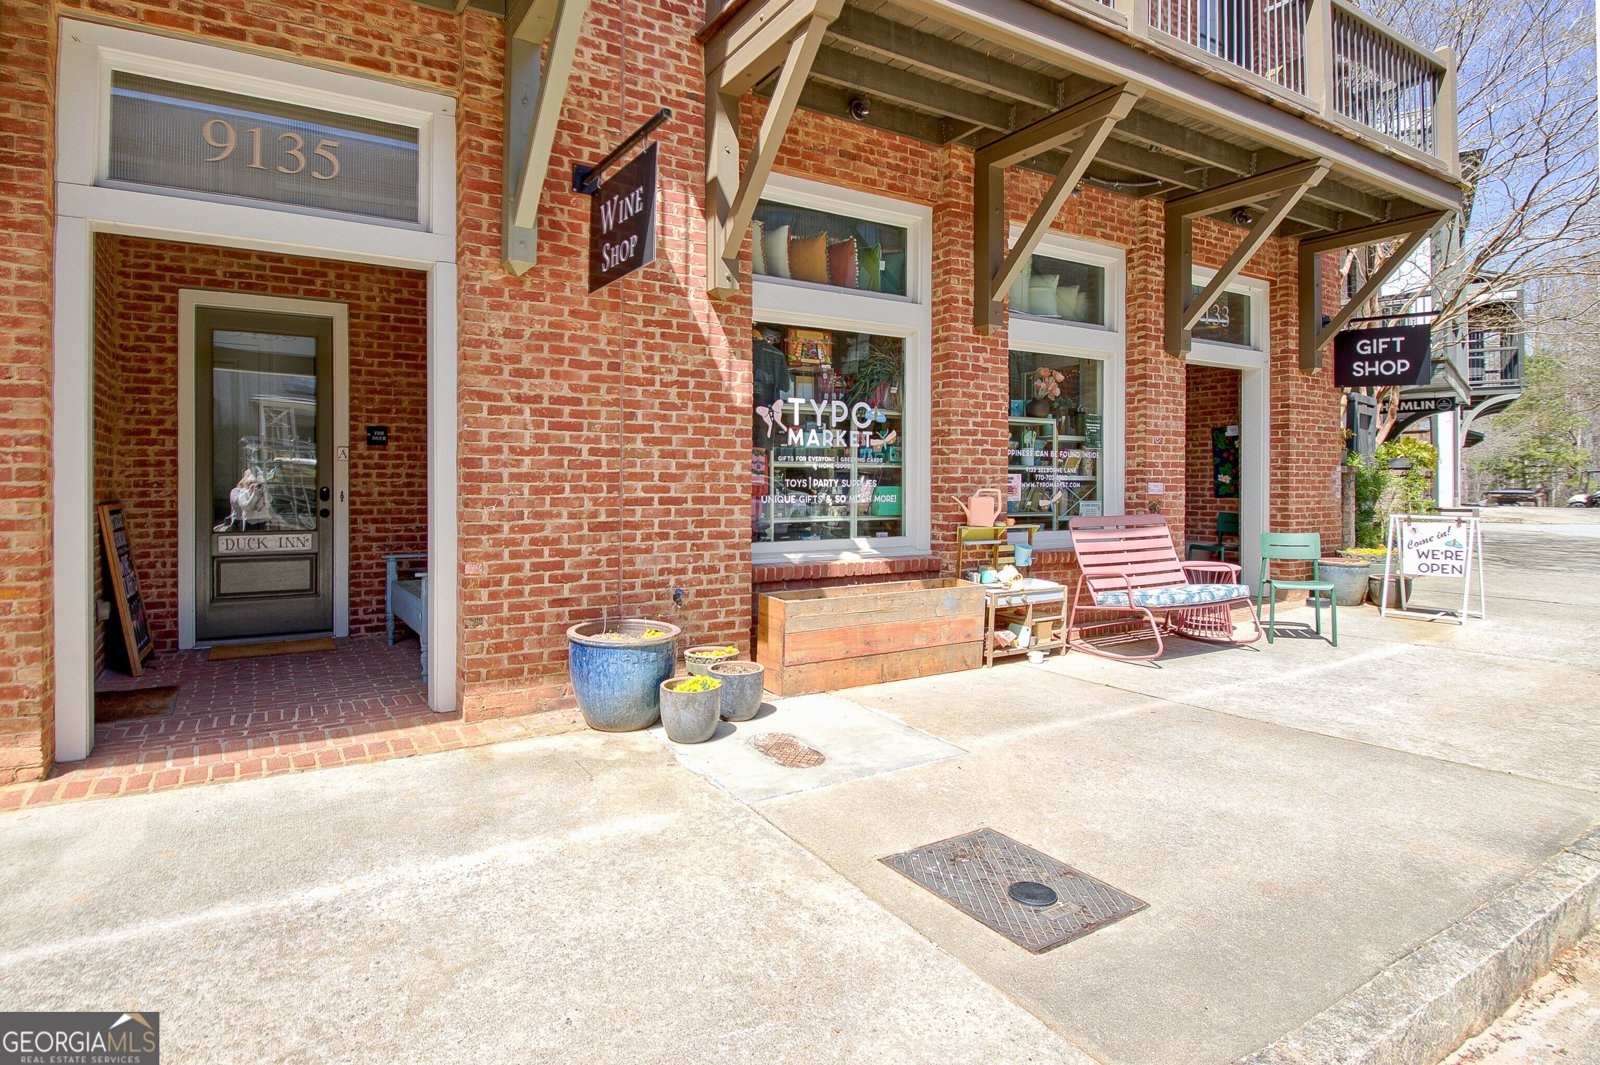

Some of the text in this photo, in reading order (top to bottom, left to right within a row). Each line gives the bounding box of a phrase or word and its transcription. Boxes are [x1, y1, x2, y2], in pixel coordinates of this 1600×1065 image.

[202, 119, 341, 181] 9135
[1356, 336, 1405, 354] GIFT
[1352, 359, 1410, 377] SHOP
[1381, 400, 1435, 411] HMLIN
[788, 398, 873, 428] TYPO
[788, 428, 873, 447] MARKET
[338, 450, 347, 459] A
[1008, 449, 1034, 457] PPINESS
[1050, 450, 1058, 458] BE
[1082, 451, 1100, 459] INSIDE
[784, 478, 808, 488] TOYS
[813, 479, 839, 488] PARTY
[841, 479, 878, 488] SUPPLIES
[761, 495, 797, 504] UNIQUE
[798, 495, 823, 504] GIFTS
[835, 495, 847, 504] SO
[874, 495, 897, 503] MORE!
[225, 536, 306, 551] DUCK INN
[1407, 526, 1452, 549] Come in!
[1416, 549, 1464, 561] WE'RE
[1418, 563, 1463, 574] OPEN
